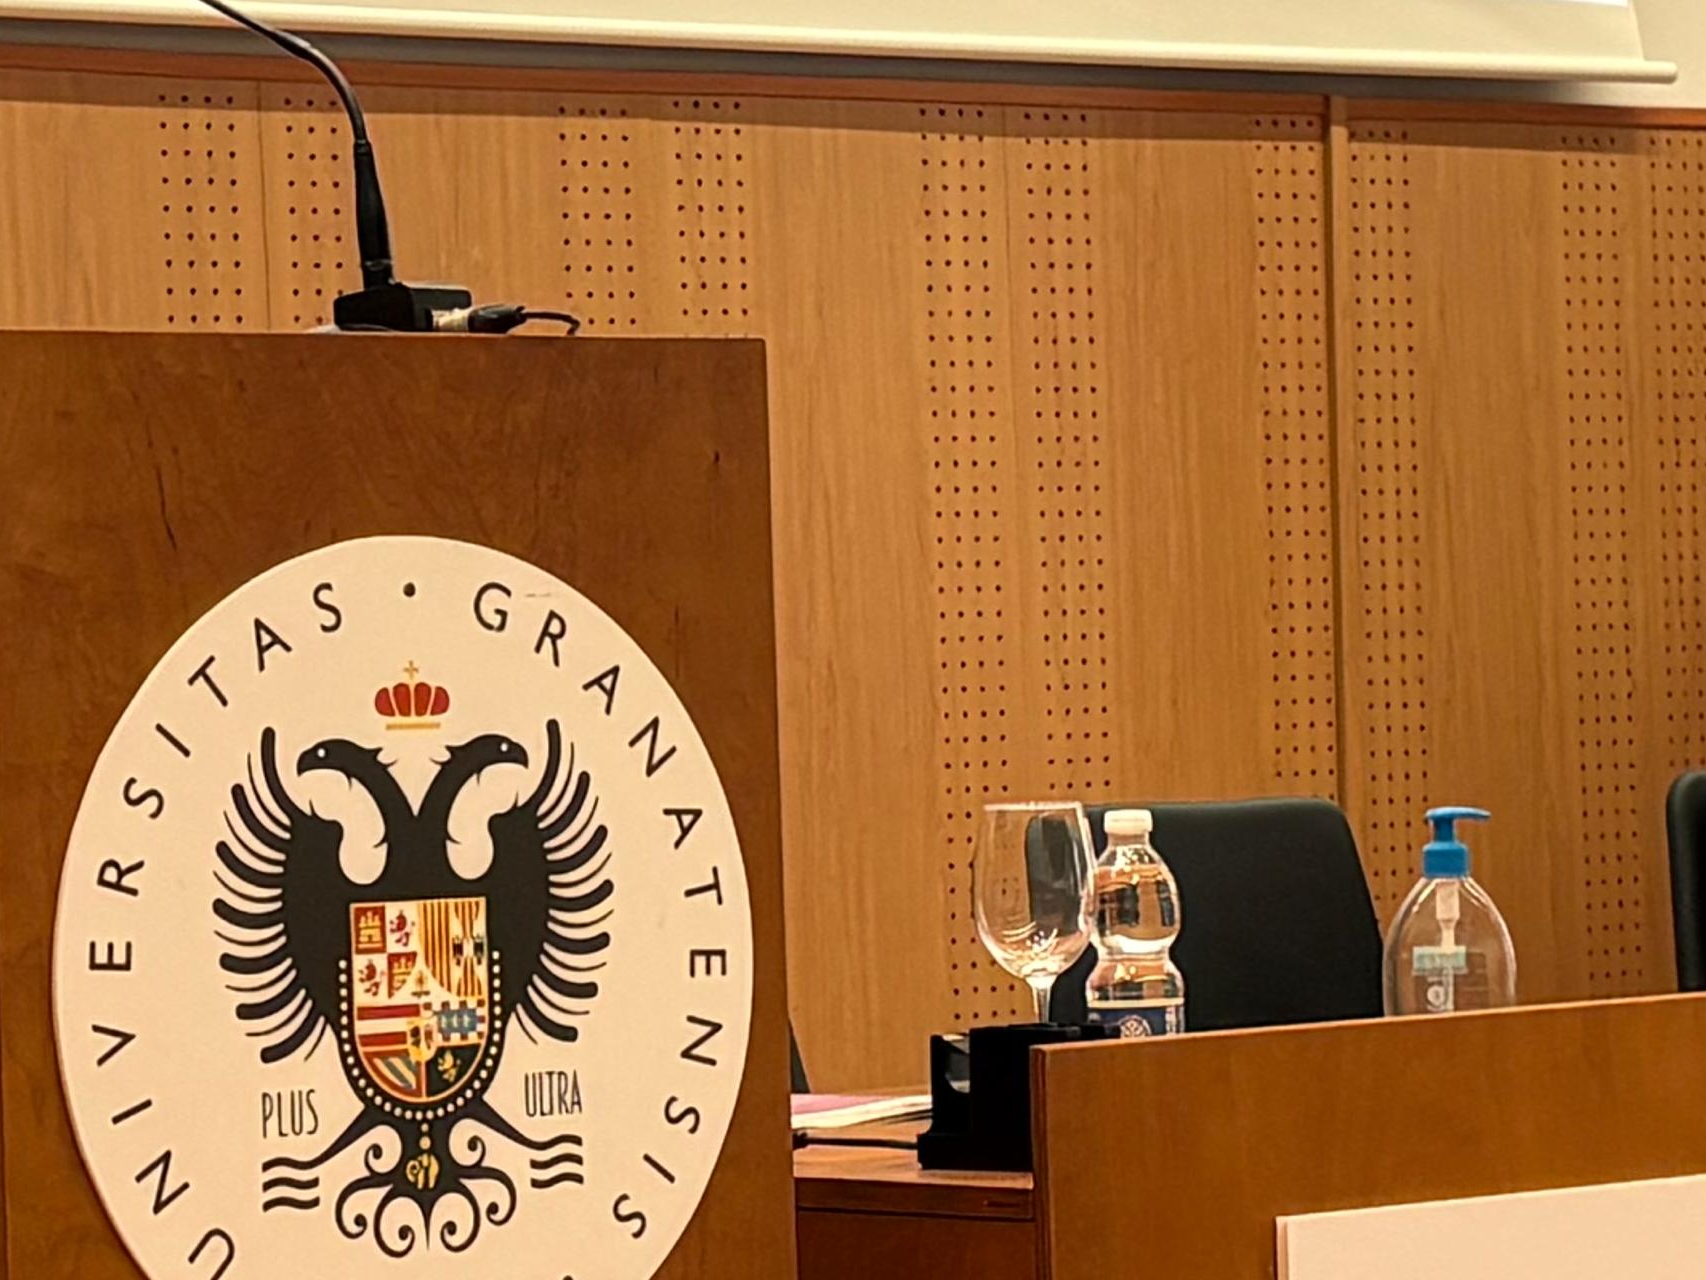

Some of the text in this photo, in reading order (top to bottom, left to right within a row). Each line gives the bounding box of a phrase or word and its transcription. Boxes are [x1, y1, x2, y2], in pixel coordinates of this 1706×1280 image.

[472, 580, 728, 1241] GRANATENSIS
[260, 1087, 319, 1139] PLUS
[523, 1068, 583, 1119] ULTRA
